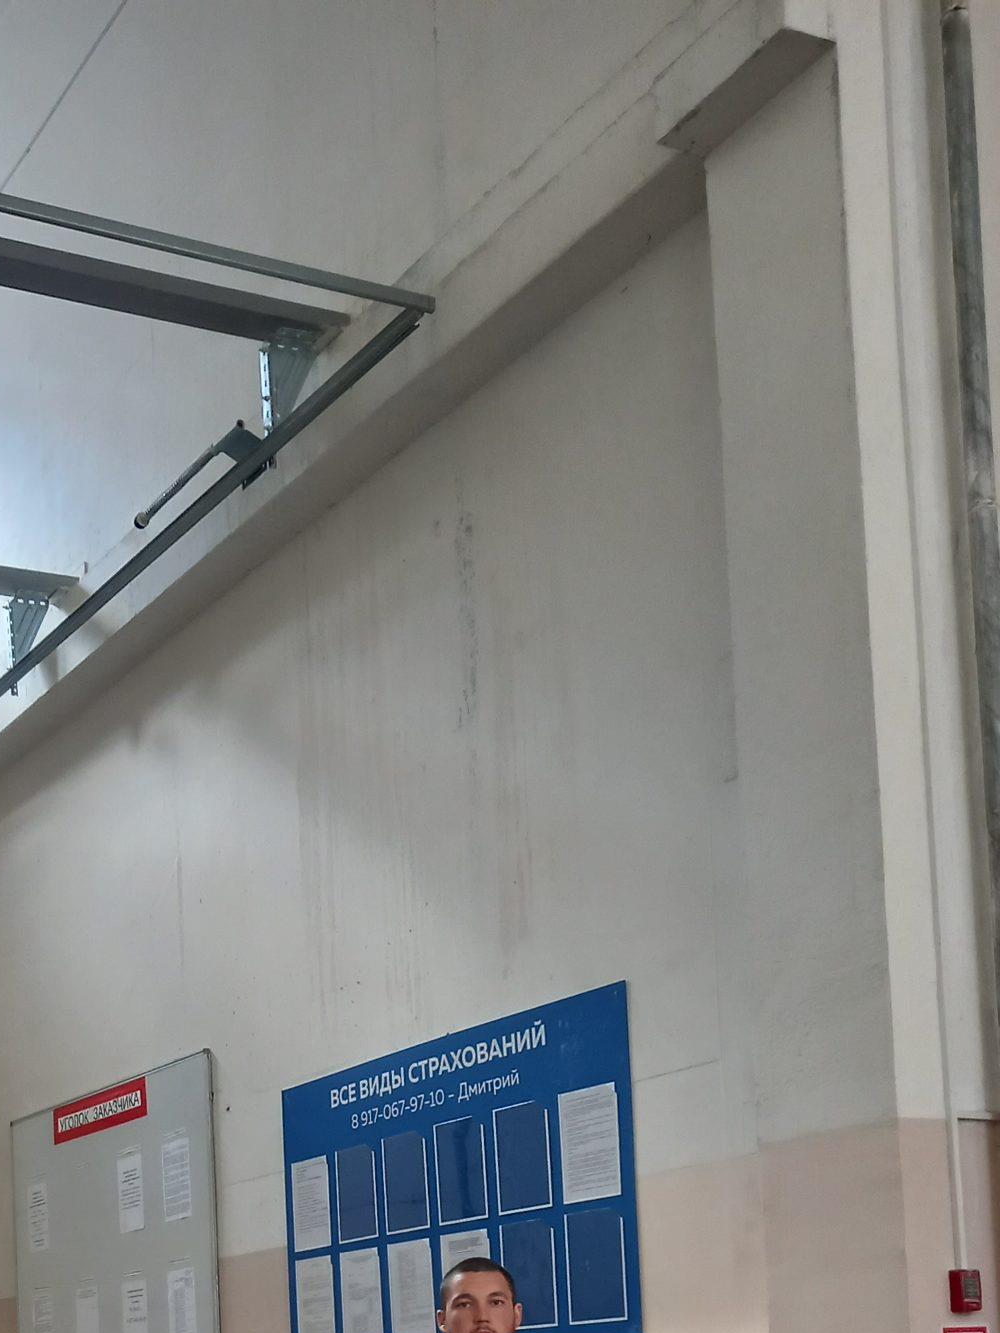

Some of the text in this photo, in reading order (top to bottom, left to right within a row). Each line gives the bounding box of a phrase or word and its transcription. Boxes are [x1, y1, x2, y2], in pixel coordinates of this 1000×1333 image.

[330, 1020, 546, 1108] ВСЕ ВИДЫ СТРАХОВАНИЙ
[59, 1092, 140, 1131] УГОЛОК ЗАКАЗЧИКА
[351, 1113, 360, 1129] 8
[360, 1089, 445, 1126] 917-067-97-10
[458, 1069, 520, 1103] Дмитрий
